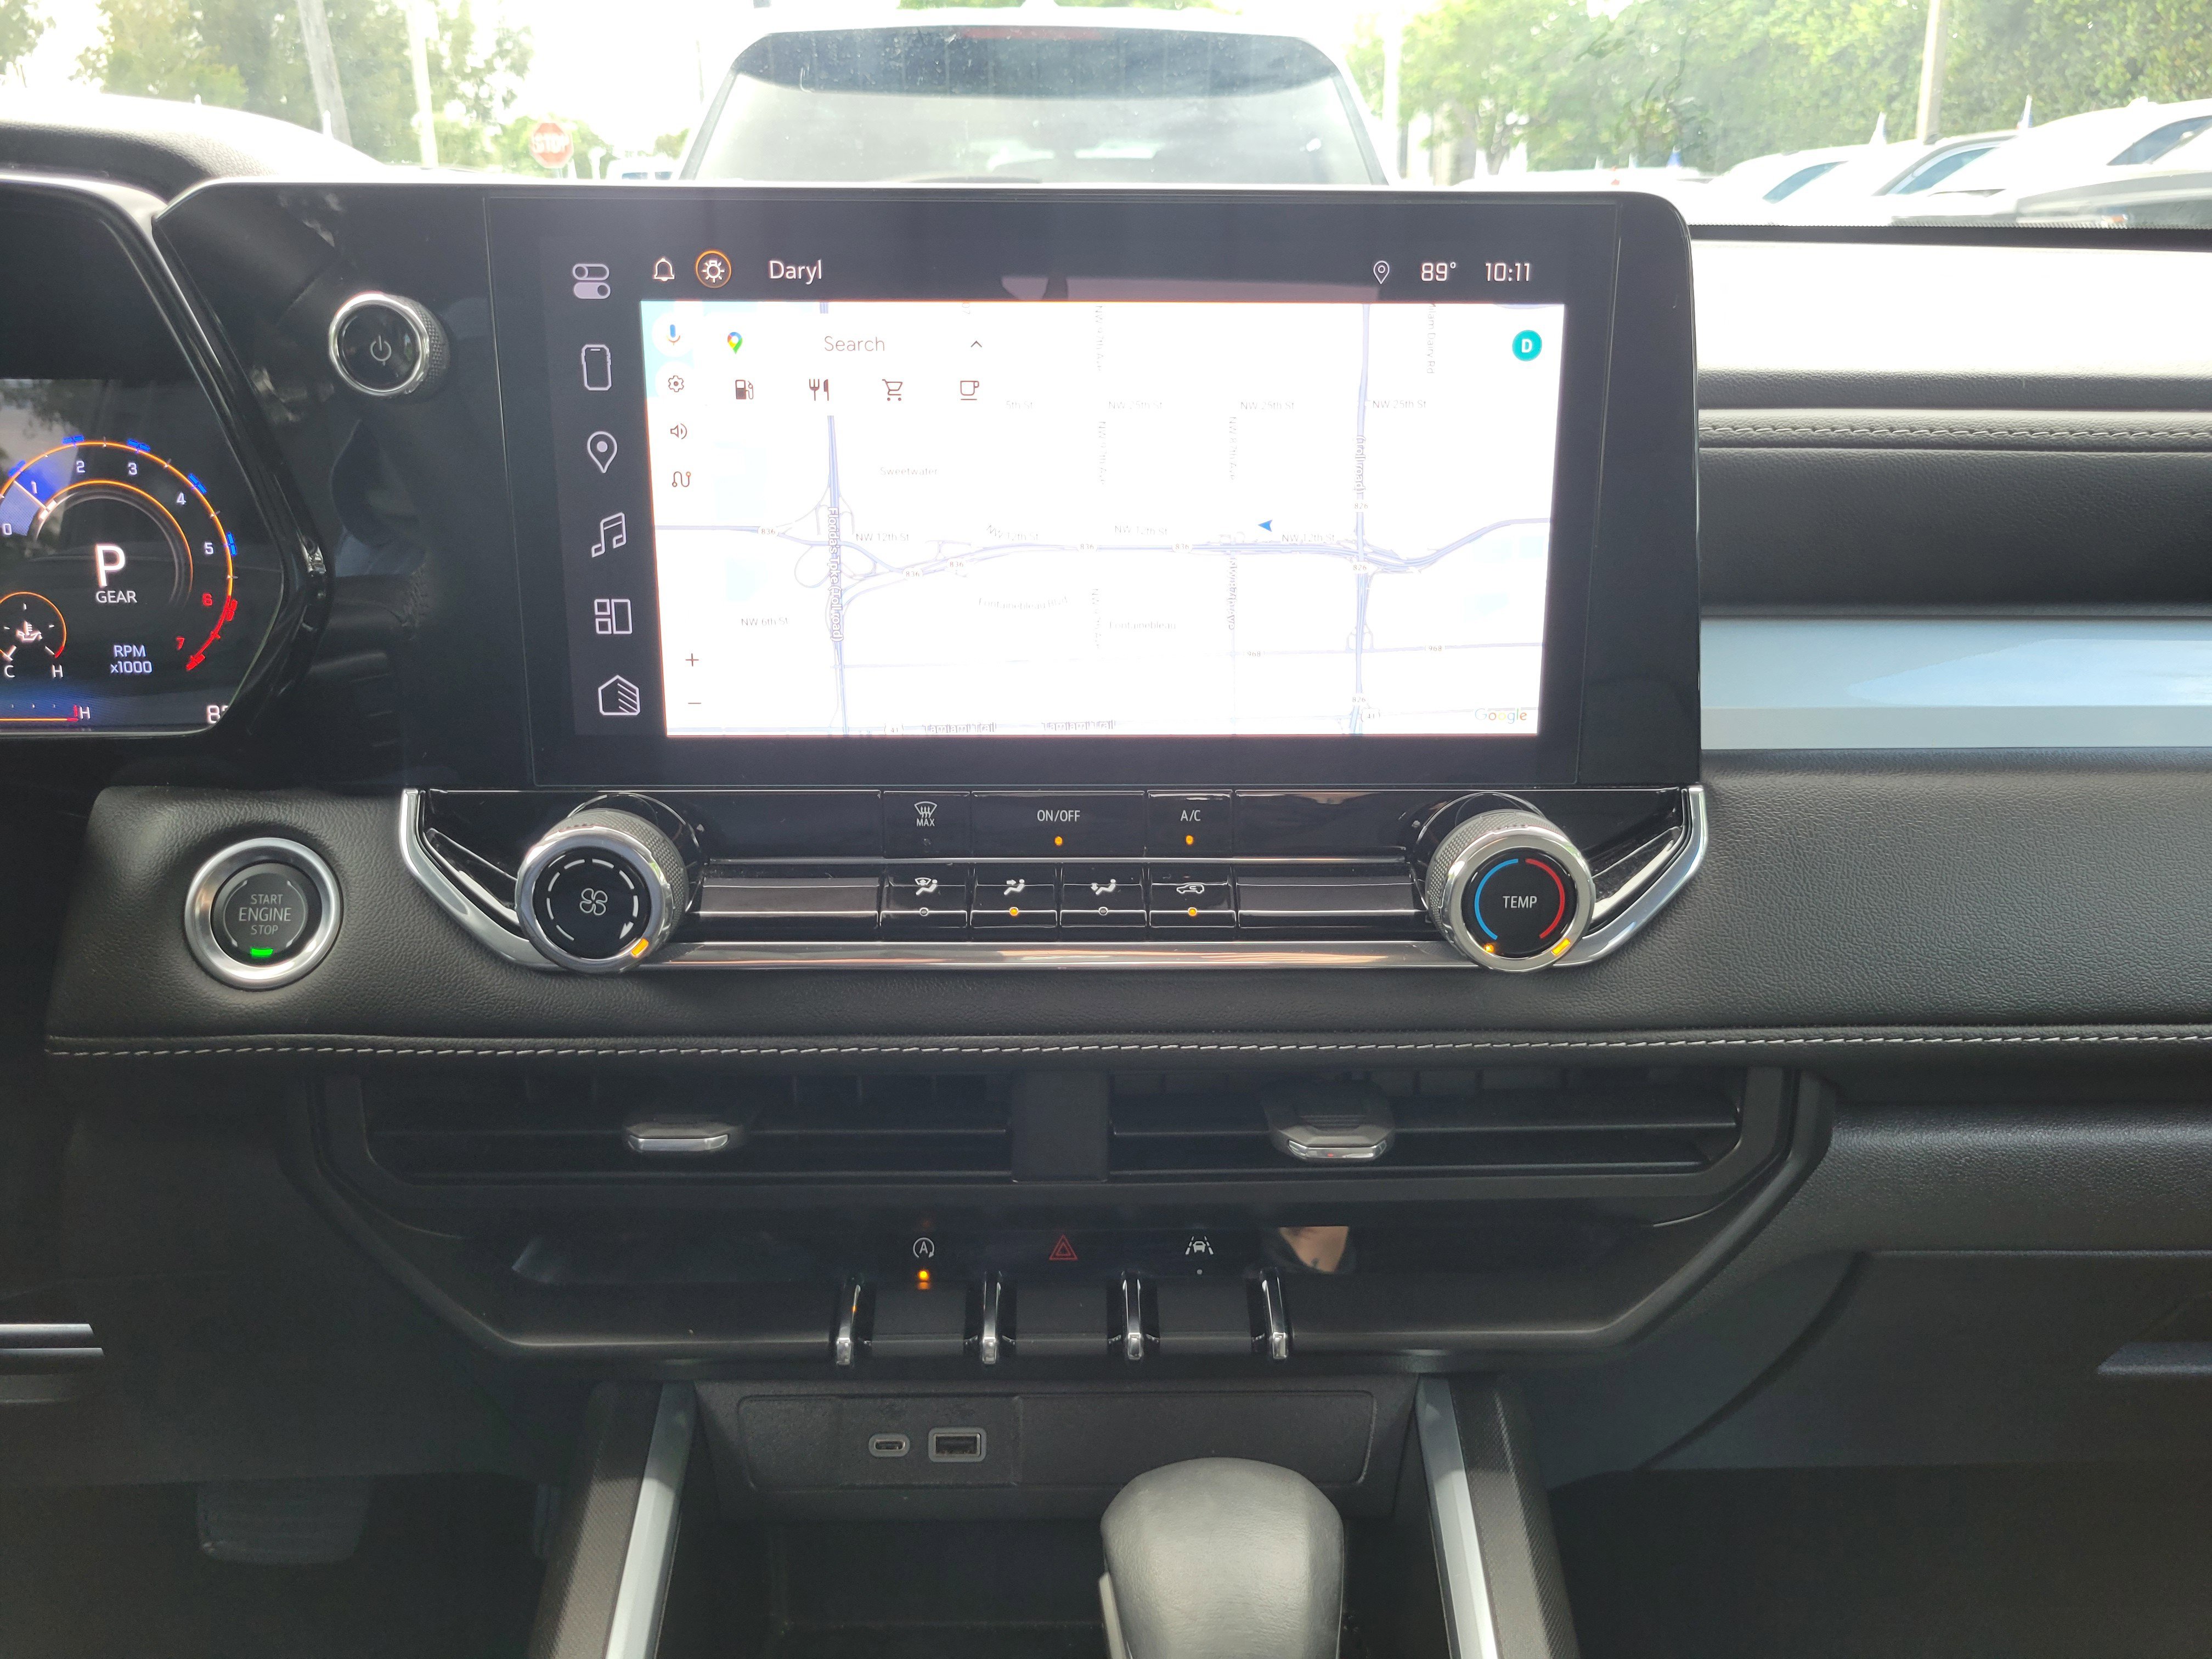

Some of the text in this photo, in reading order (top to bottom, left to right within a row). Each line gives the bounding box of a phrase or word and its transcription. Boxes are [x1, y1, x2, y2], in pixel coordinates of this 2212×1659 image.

[534, 133, 569, 154] STOP
[769, 260, 822, 284] Daryl
[1485, 262, 1530, 281] 10:11
[824, 336, 885, 351] Search
[1521, 339, 1532, 353] D
[1427, 361, 1436, 374] Rd
[1108, 401, 1126, 409] NW
[1240, 401, 1258, 410] NW
[1373, 400, 1426, 409] NW 25th St
[1229, 417, 1237, 435] NW
[77, 460, 85, 473] 2
[128, 462, 137, 475] 3
[880, 466, 938, 476] Sweetwater
[177, 492, 186, 505] 4
[3, 523, 12, 535] 0
[1114, 525, 1132, 535] NW
[1159, 527, 1168, 536] St
[856, 533, 910, 542] NW 12th St
[1282, 534, 1299, 543] NW
[205, 543, 213, 555] 5
[95, 544, 125, 586] P
[827, 507, 843, 641] Florida's Tpke (Toll road)
[96, 591, 137, 603] GEAR
[202, 593, 212, 606] 6
[741, 618, 757, 627] NW
[778, 617, 788, 625] St
[176, 636, 184, 650] 7
[114, 645, 146, 657] RPM
[4, 666, 14, 678] C
[52, 665, 63, 678] H
[110, 661, 153, 674] x1000
[79, 707, 90, 719] H
[1475, 708, 1527, 725] Google
[1037, 810, 1080, 822] ON/OFF
[1181, 810, 1200, 821] A/C
[251, 894, 283, 904] START
[1503, 896, 1537, 909] TEMP
[239, 907, 292, 921] ENGINE
[251, 925, 278, 935] STOP
